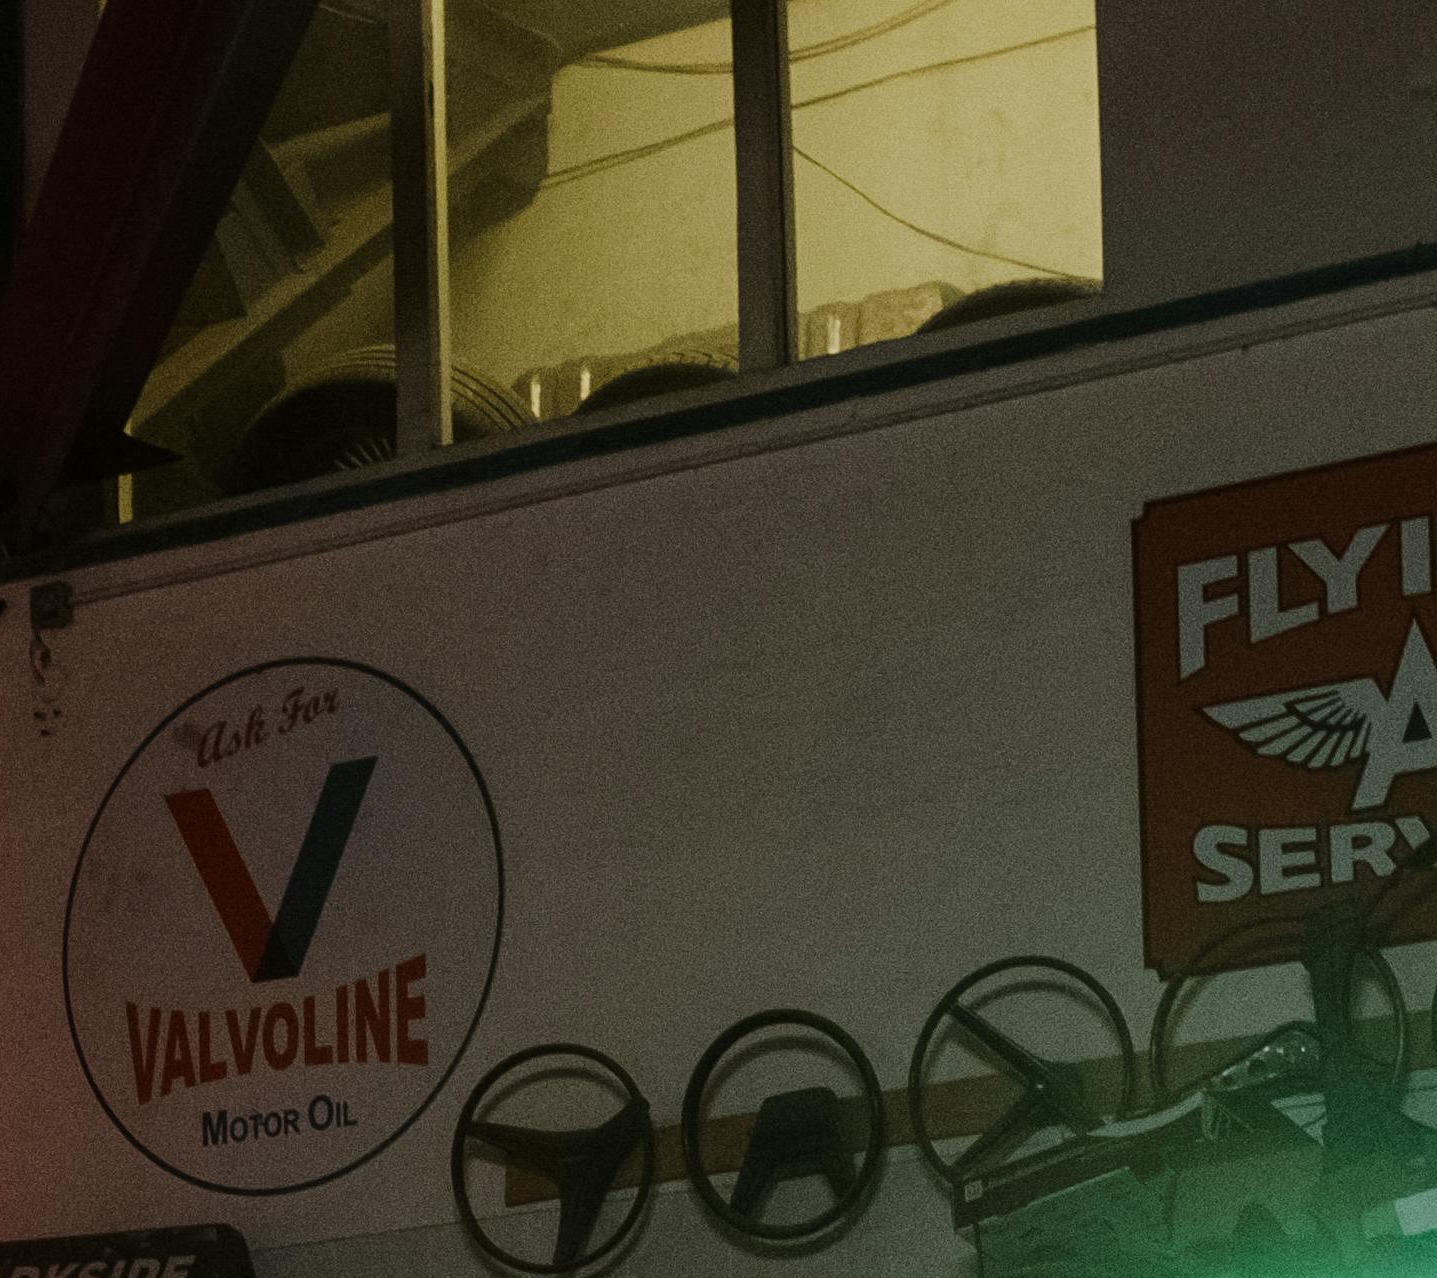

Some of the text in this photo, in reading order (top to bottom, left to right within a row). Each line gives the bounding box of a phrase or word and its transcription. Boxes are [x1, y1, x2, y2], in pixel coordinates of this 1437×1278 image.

[196, 685, 342, 767] Ask For
[125, 953, 428, 1105] VALVOLINE
[202, 1109, 301, 1147] MOTOR
